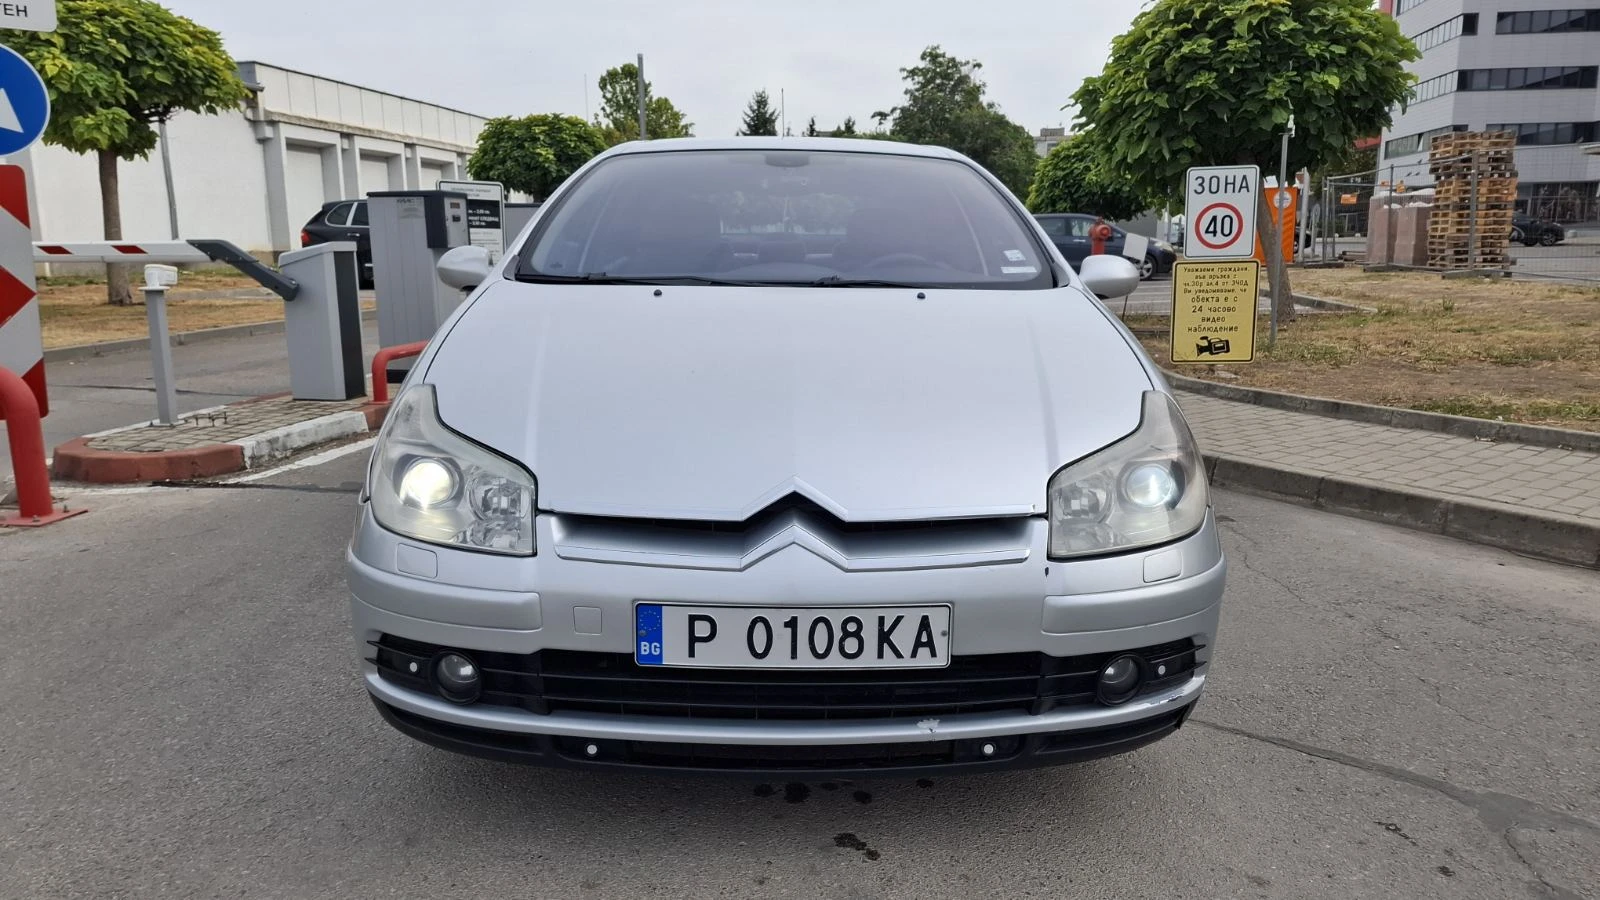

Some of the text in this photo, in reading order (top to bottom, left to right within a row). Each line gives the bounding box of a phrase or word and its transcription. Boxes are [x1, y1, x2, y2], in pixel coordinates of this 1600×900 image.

[0, 3, 28, 18] ЕН
[1194, 175, 1250, 195] ЗОНА
[1205, 214, 1234, 238] 40
[1191, 295, 1220, 303] обекта
[1192, 305, 1203, 313] 24
[1201, 316, 1226, 324] видео
[1187, 325, 1239, 333] наблюдение
[688, 614, 718, 658] P
[640, 641, 661, 656] BG
